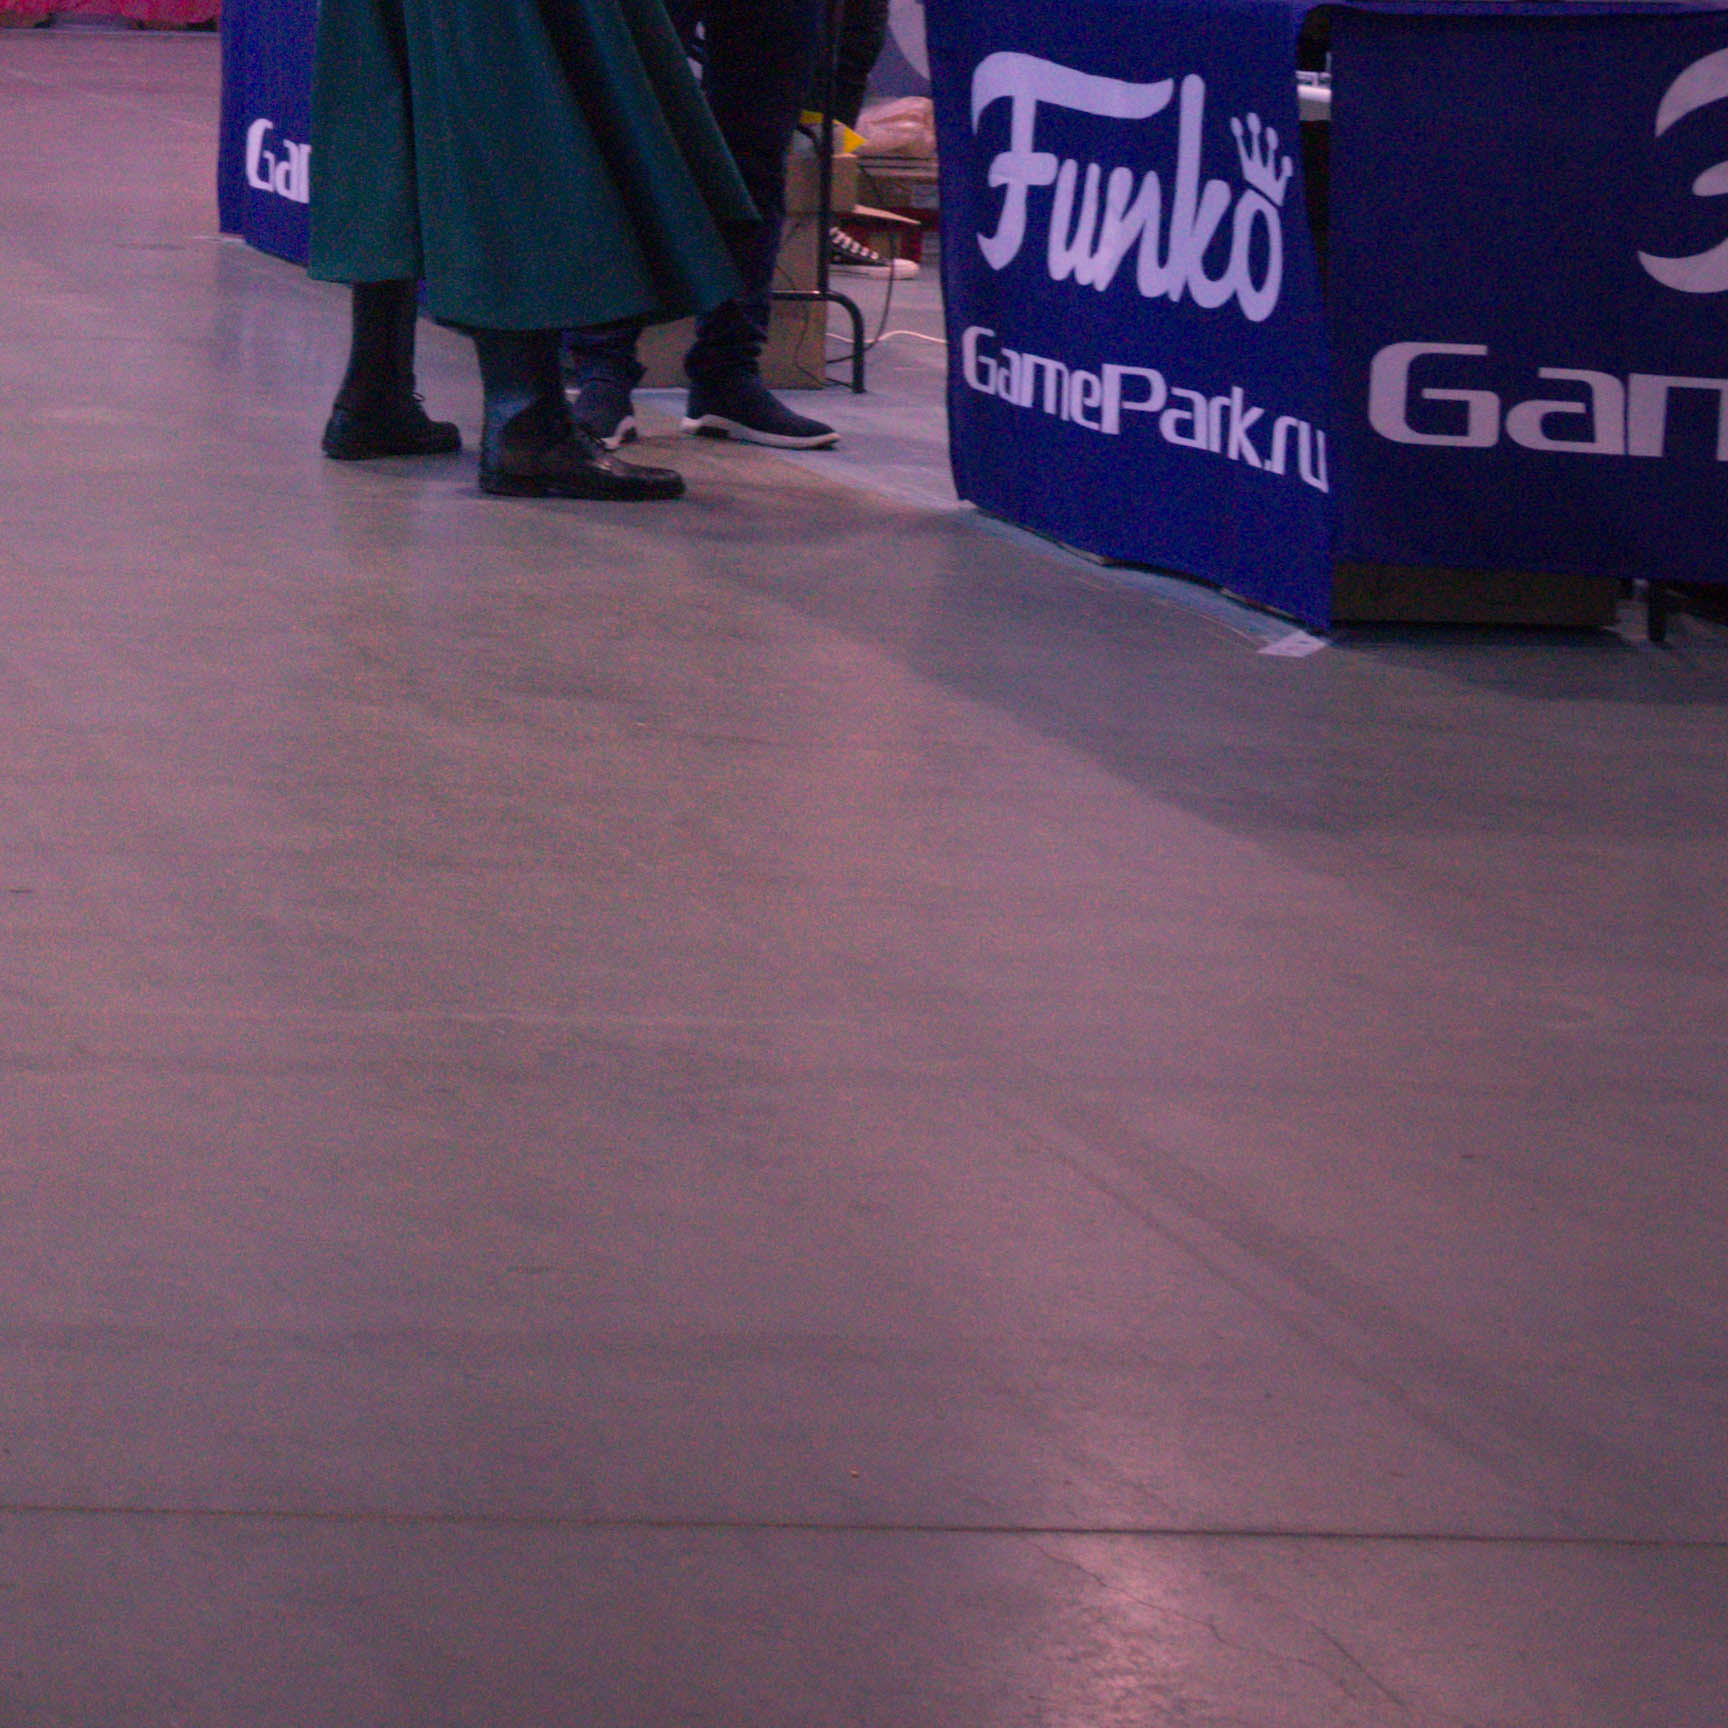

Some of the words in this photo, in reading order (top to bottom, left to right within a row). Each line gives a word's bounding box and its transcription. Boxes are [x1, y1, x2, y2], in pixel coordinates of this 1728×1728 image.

[246, 118, 311, 204] Ga
[971, 51, 1284, 322] Funko
[962, 325, 1329, 494] GamePark.ru
